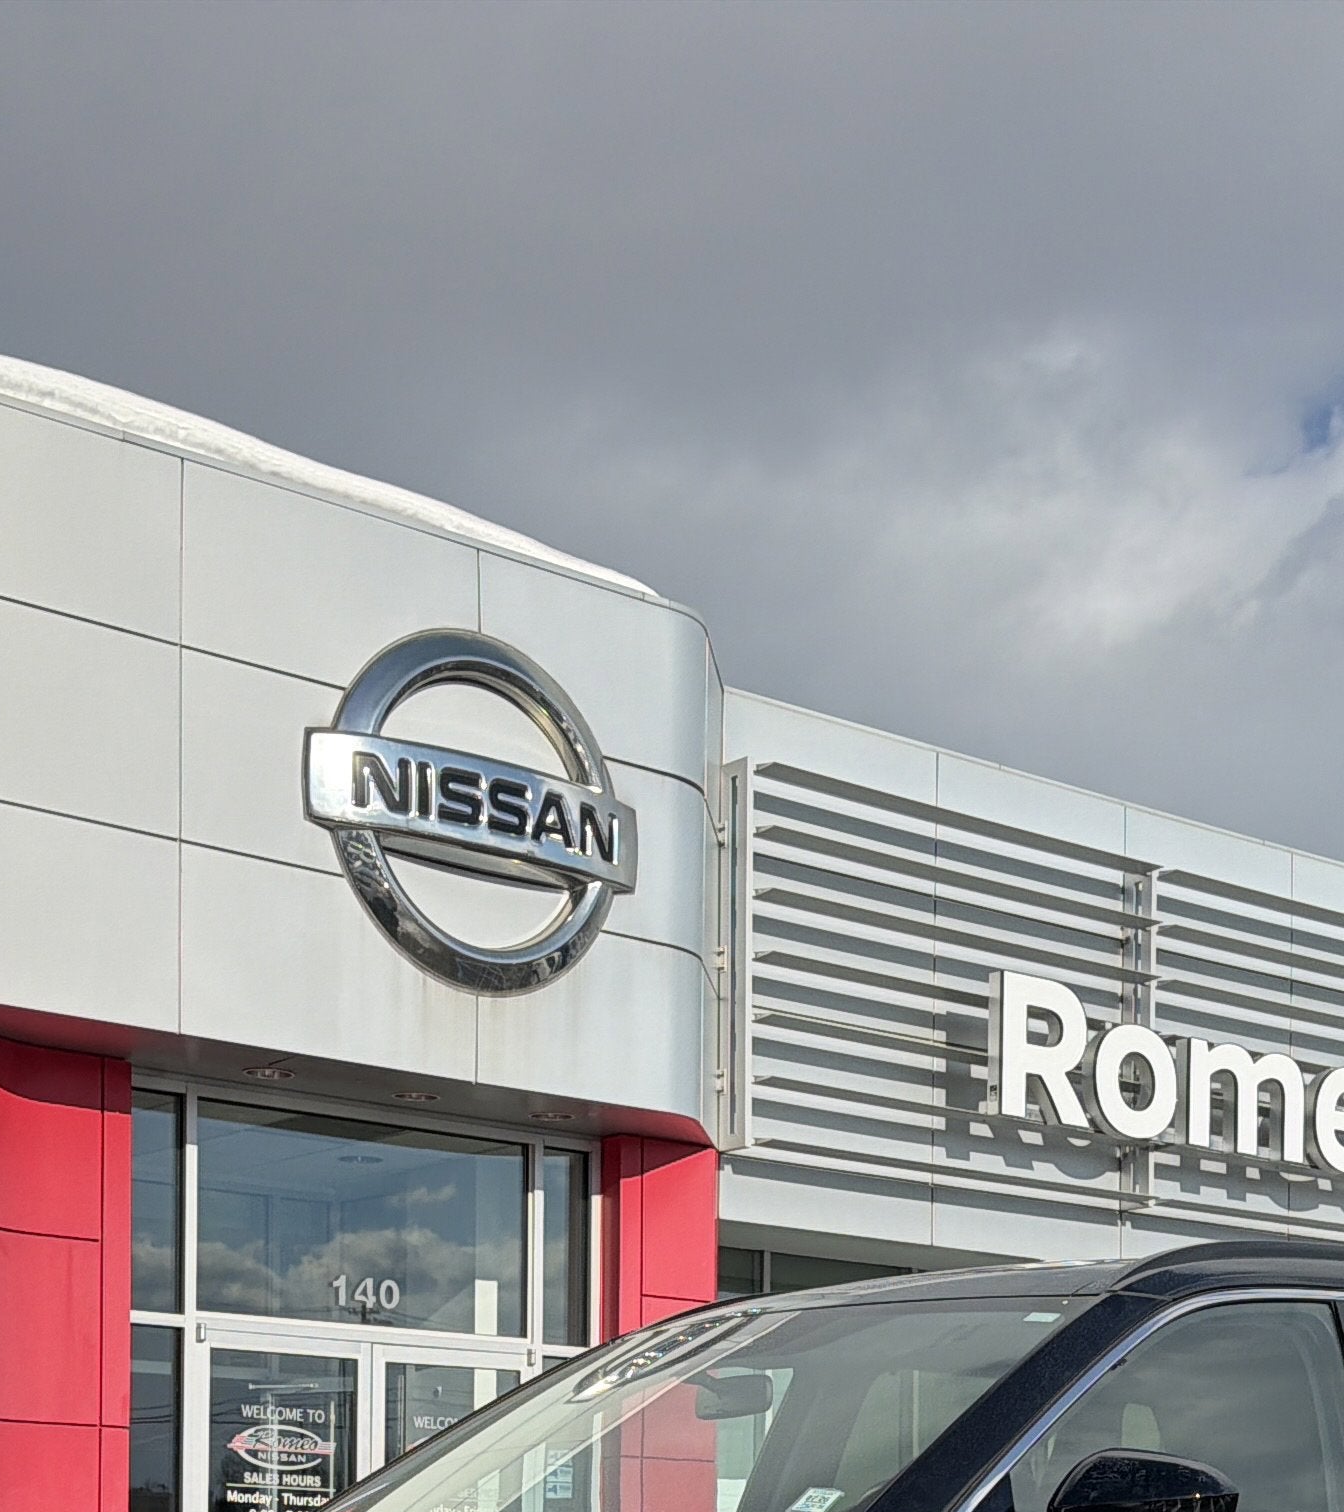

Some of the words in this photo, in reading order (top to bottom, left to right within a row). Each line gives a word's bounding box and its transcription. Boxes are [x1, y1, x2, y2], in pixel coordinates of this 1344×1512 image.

[352, 750, 620, 865] NISSAN
[331, 1274, 400, 1310] 140
[241, 1404, 304, 1421] WELCOME
[307, 1408, 326, 1424] TO
[413, 1415, 458, 1430] WELCO
[252, 1430, 318, 1452] Romeo
[258, 1450, 307, 1463] NISSAN
[243, 1472, 280, 1485] SALES
[282, 1474, 322, 1488] HOURS
[227, 1490, 272, 1508] Monday
